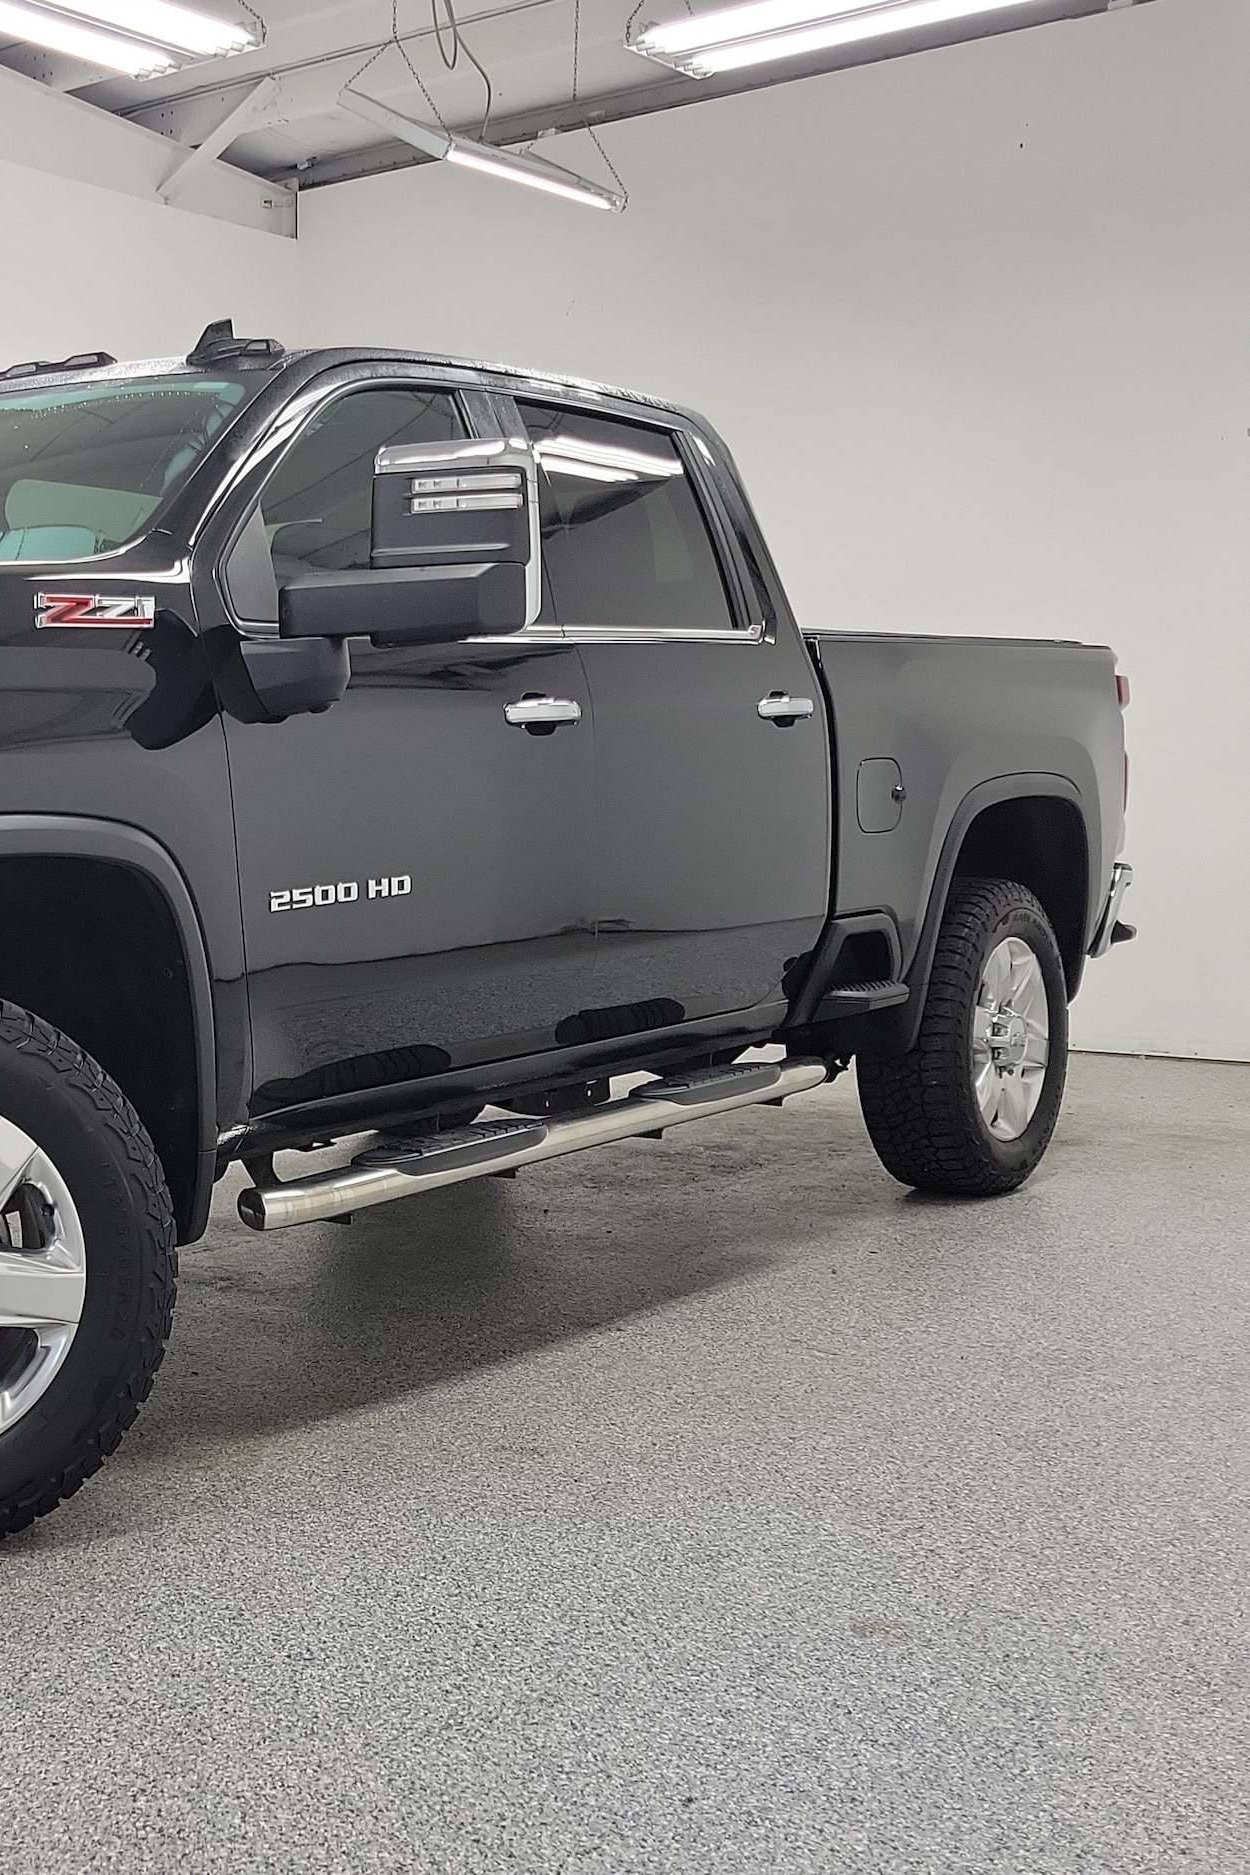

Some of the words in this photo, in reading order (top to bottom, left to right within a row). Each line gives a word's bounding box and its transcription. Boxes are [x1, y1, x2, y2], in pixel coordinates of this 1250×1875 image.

[34, 592, 156, 629] Z71
[269, 881, 359, 912] 2500
[368, 875, 413, 899] HD
